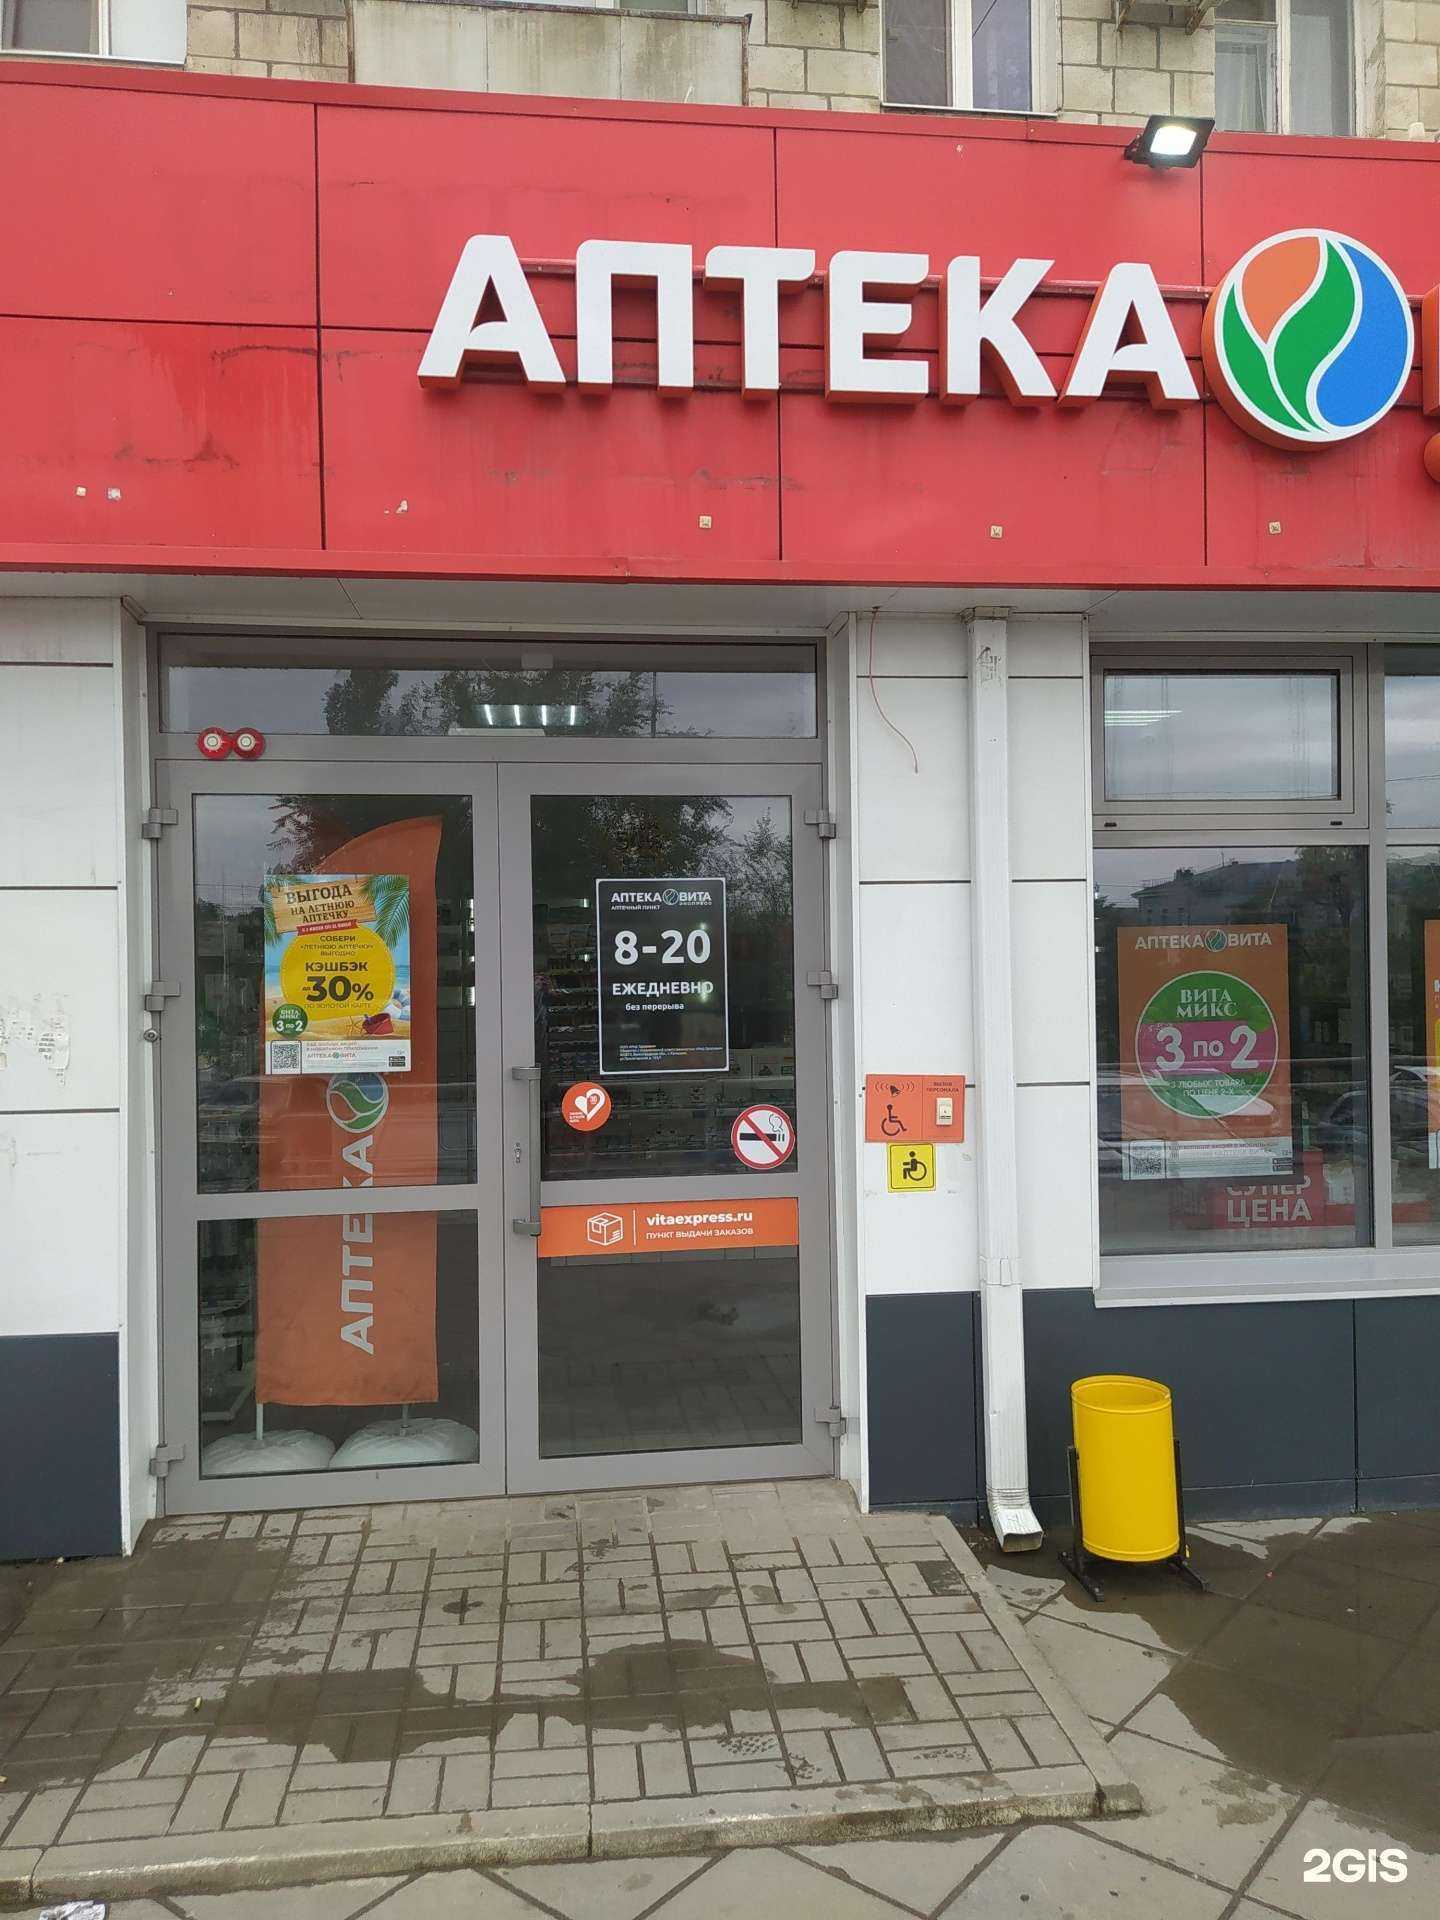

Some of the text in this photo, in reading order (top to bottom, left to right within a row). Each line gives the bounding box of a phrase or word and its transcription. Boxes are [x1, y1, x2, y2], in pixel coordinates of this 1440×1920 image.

[417, 234, 1200, 402] АПТЕКА
[286, 884, 353, 905] ВЫГОДА
[611, 891, 712, 903] АПТЕКА ВИТА
[291, 900, 356, 916] НА ЛЕТНЮЮ
[302, 910, 349, 924] АПТЕЧКУ
[614, 929, 711, 966] 8-20
[1135, 932, 1273, 951] АПТЕКА ВИТА
[305, 961, 369, 972] КЭШБЭК
[306, 975, 374, 1002] 30%
[612, 981, 714, 998] ЕЖЕДНЕВНО
[1180, 988, 1233, 1004] ВИТА
[625, 1002, 685, 1014] без перерыва
[1176, 1002, 1239, 1018] МИКС
[276, 1020, 285, 1032] 3
[295, 1020, 304, 1032] 2
[1155, 1025, 1260, 1071] 3 по 2
[646, 1212, 753, 1227] vitaexpress.ru
[1227, 1198, 1313, 1228] ЦЕНА
[646, 1227, 754, 1240] ПУНКТ ВЫДАЧИ ЗАКАЗОВ
